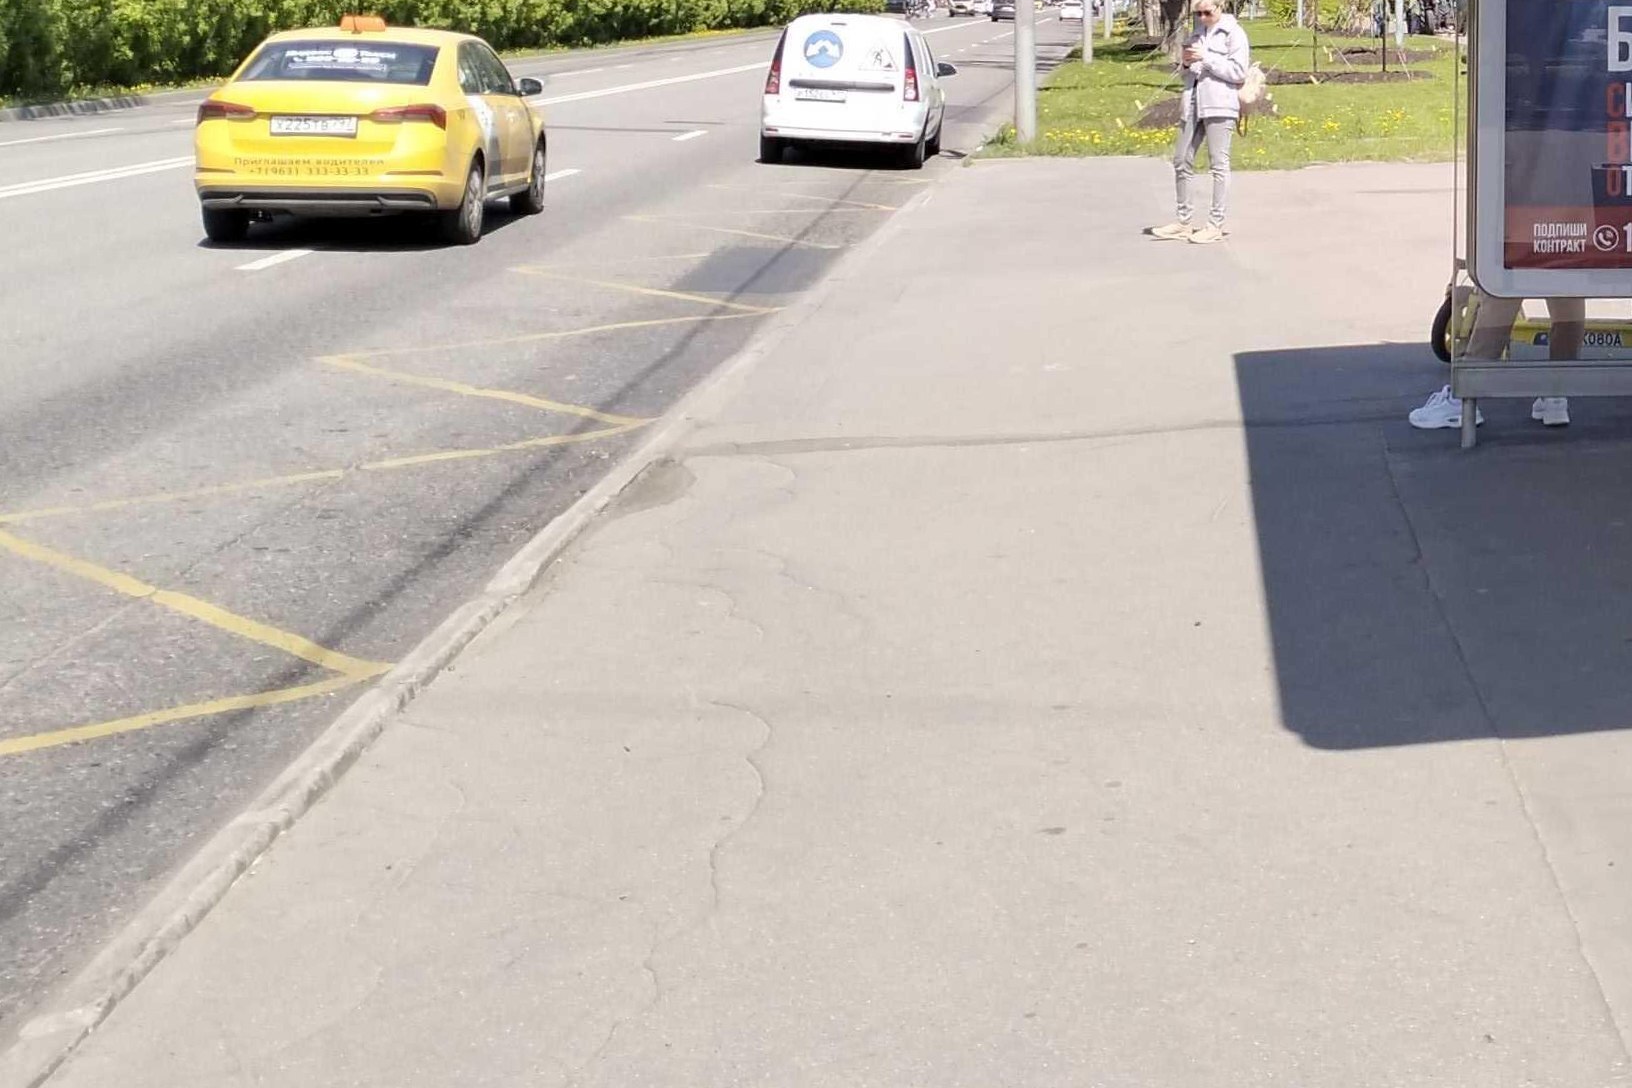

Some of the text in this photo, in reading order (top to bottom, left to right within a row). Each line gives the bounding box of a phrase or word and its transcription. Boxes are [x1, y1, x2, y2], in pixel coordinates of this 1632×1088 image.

[234, 157, 311, 166] Приглашаем
[1533, 223, 1588, 237] ПОДПИШИ
[1533, 238, 1587, 253] КОНТРАКТ
